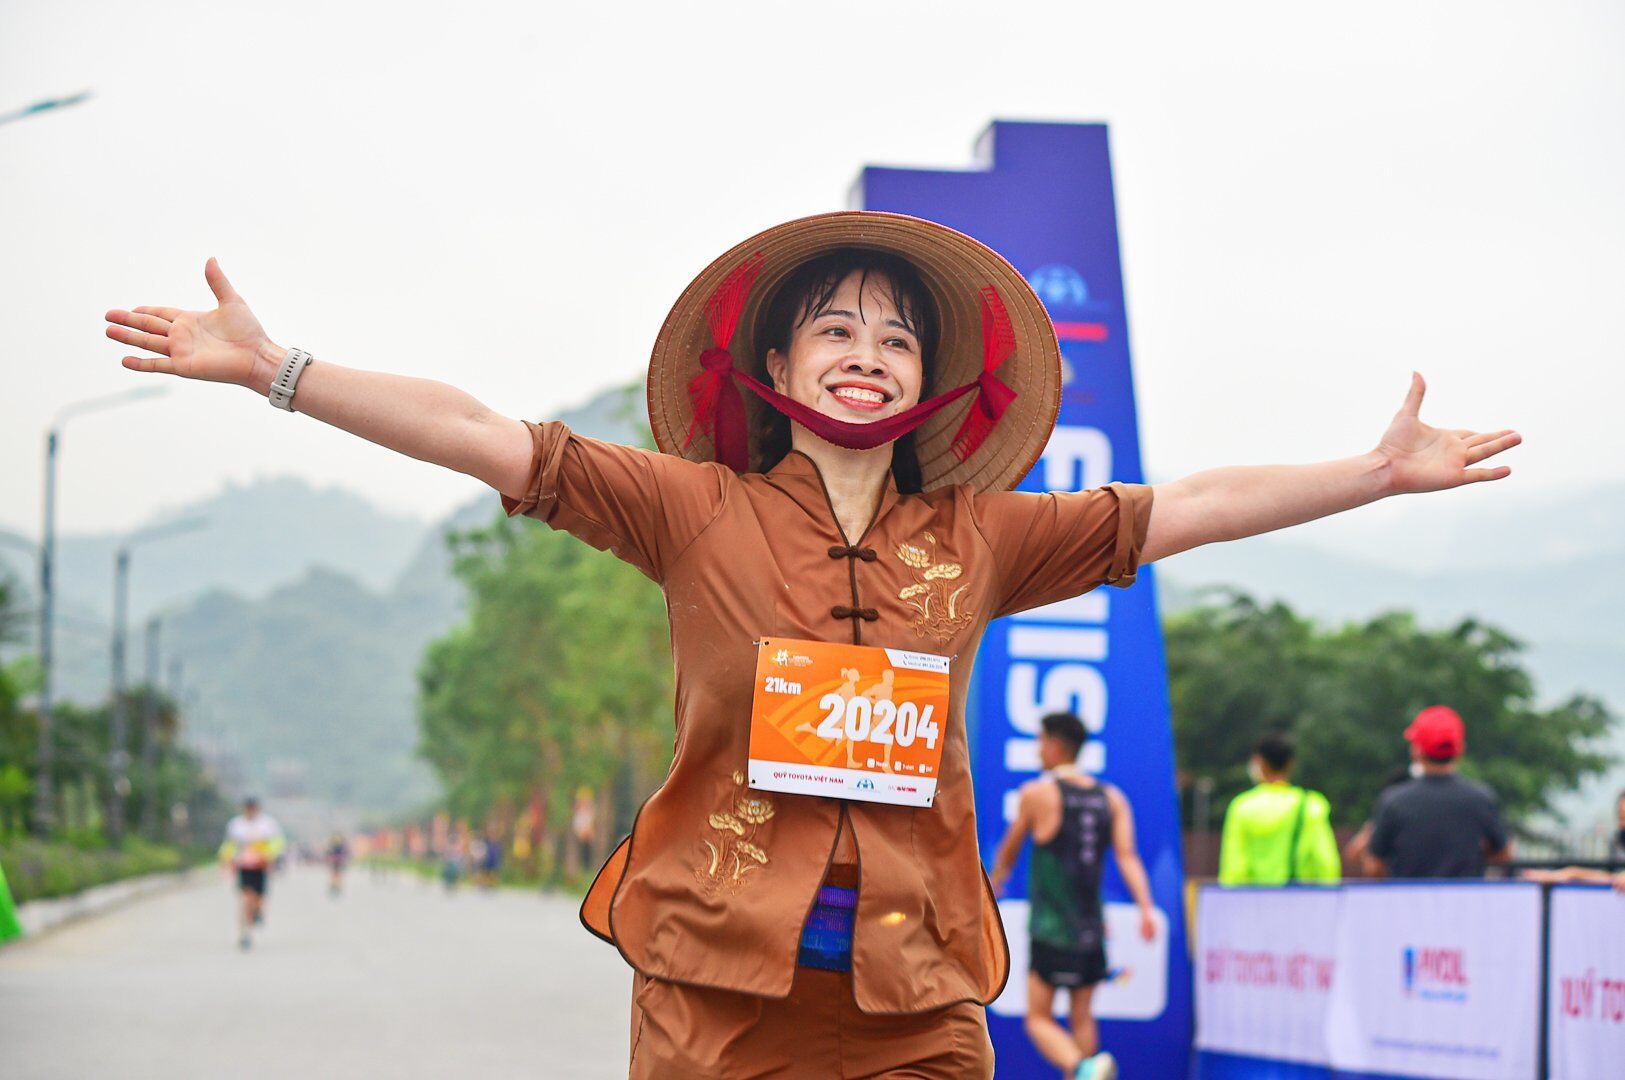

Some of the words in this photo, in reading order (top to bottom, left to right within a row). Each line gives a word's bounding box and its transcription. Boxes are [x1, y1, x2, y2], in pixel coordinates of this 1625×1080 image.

[765, 677, 802, 696] 21km
[816, 693, 939, 750] 20204
[788, 772, 813, 781] TOYOTA
[829, 777, 844, 785] NAM
